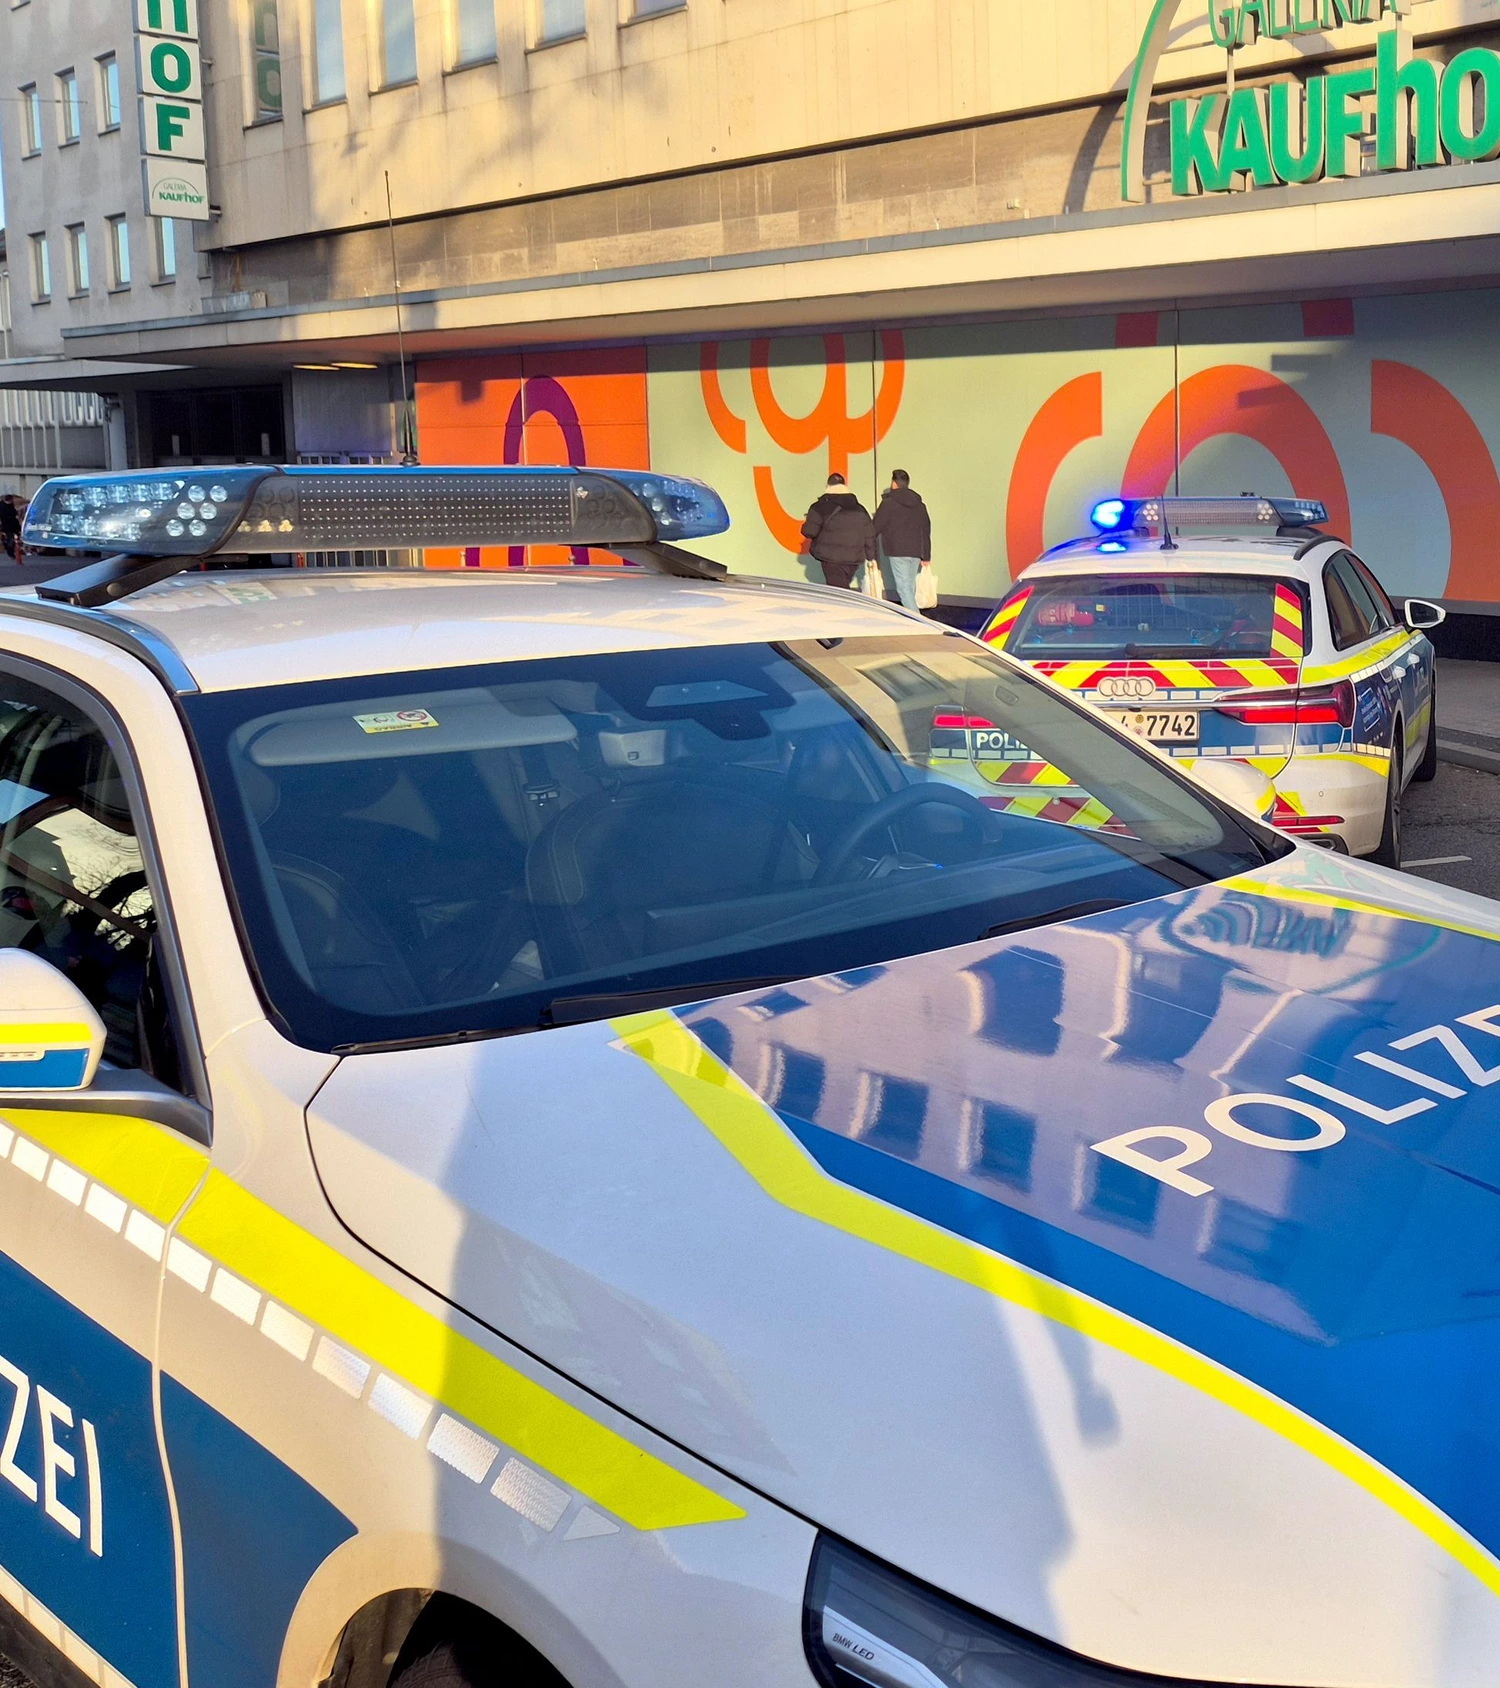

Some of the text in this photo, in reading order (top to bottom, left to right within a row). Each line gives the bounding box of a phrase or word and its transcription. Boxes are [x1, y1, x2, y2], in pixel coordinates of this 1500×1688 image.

[1147, 715, 1195, 736] 7742
[832, 1633, 875, 1661] BMW LED
